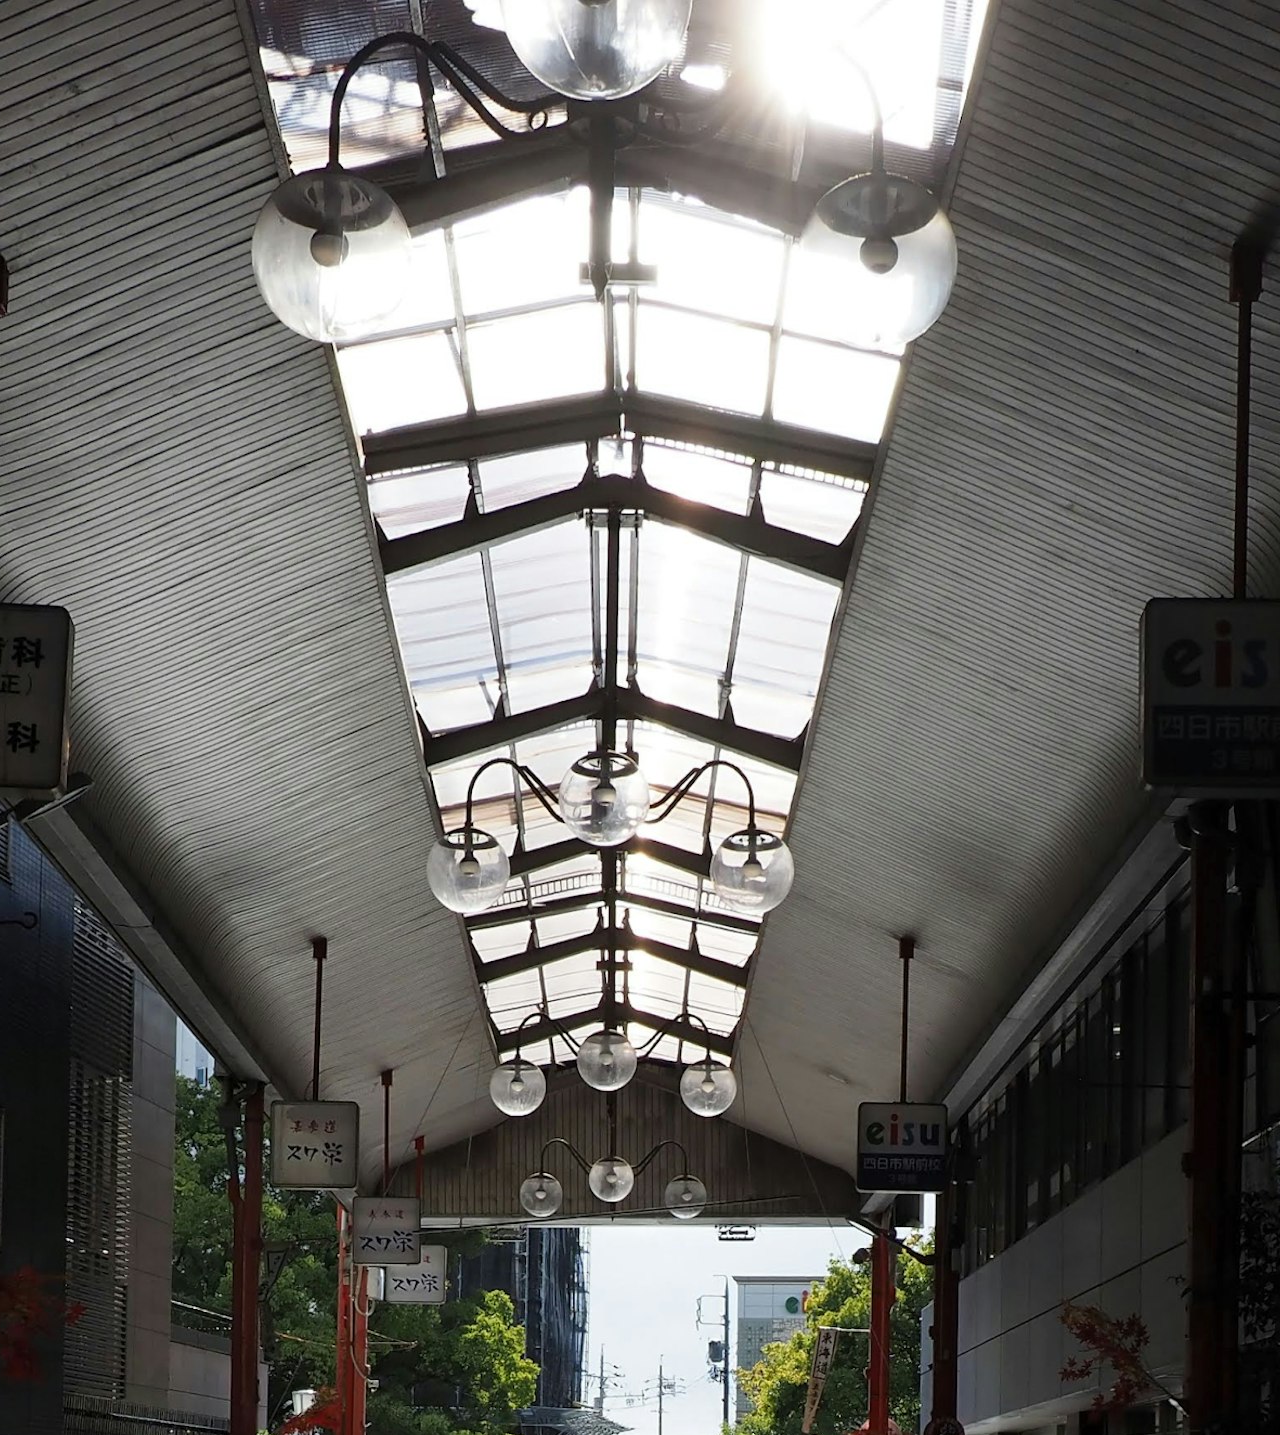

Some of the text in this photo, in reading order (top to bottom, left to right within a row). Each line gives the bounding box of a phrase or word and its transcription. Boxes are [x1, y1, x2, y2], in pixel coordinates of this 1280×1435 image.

[866, 1113, 940, 1146] eisu
[287, 1142, 344, 1167] スワ栄
[359, 1230, 415, 1253] スワ栄
[392, 1274, 439, 1292] スワ栄
